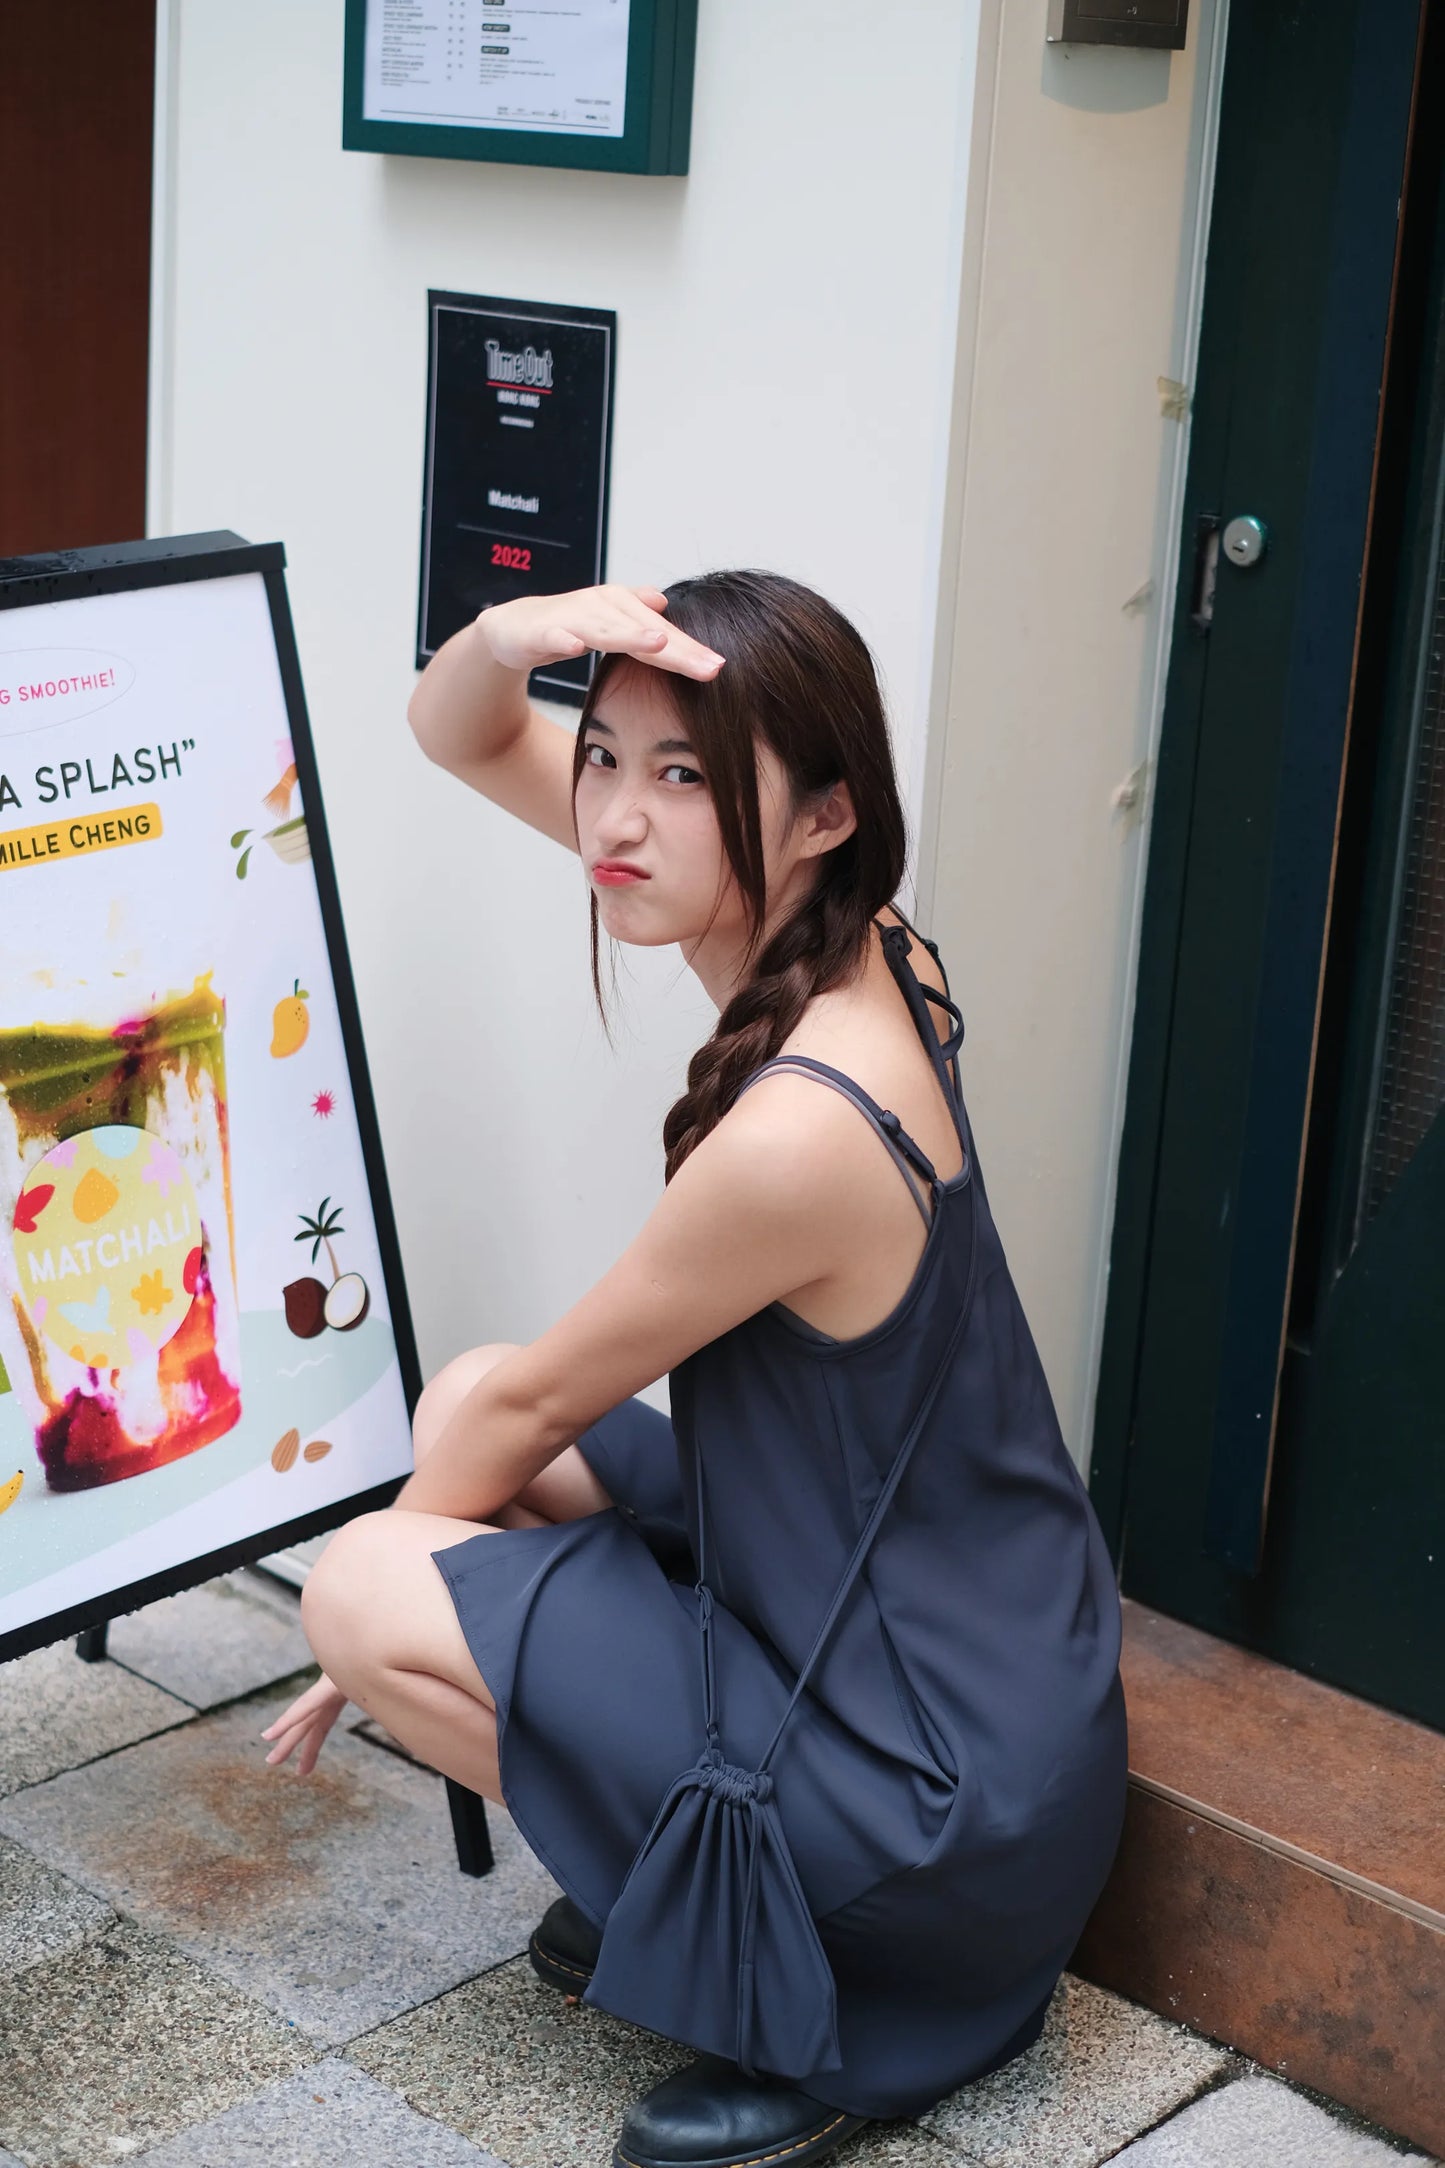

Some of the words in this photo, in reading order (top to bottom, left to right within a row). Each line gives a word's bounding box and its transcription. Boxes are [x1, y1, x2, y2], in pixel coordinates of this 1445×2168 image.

[488, 489, 540, 514] Matchali
[491, 543, 532, 571] 2022
[18, 668, 116, 702] SMOOTHIE!
[27, 1202, 192, 1284] MATCHALI
